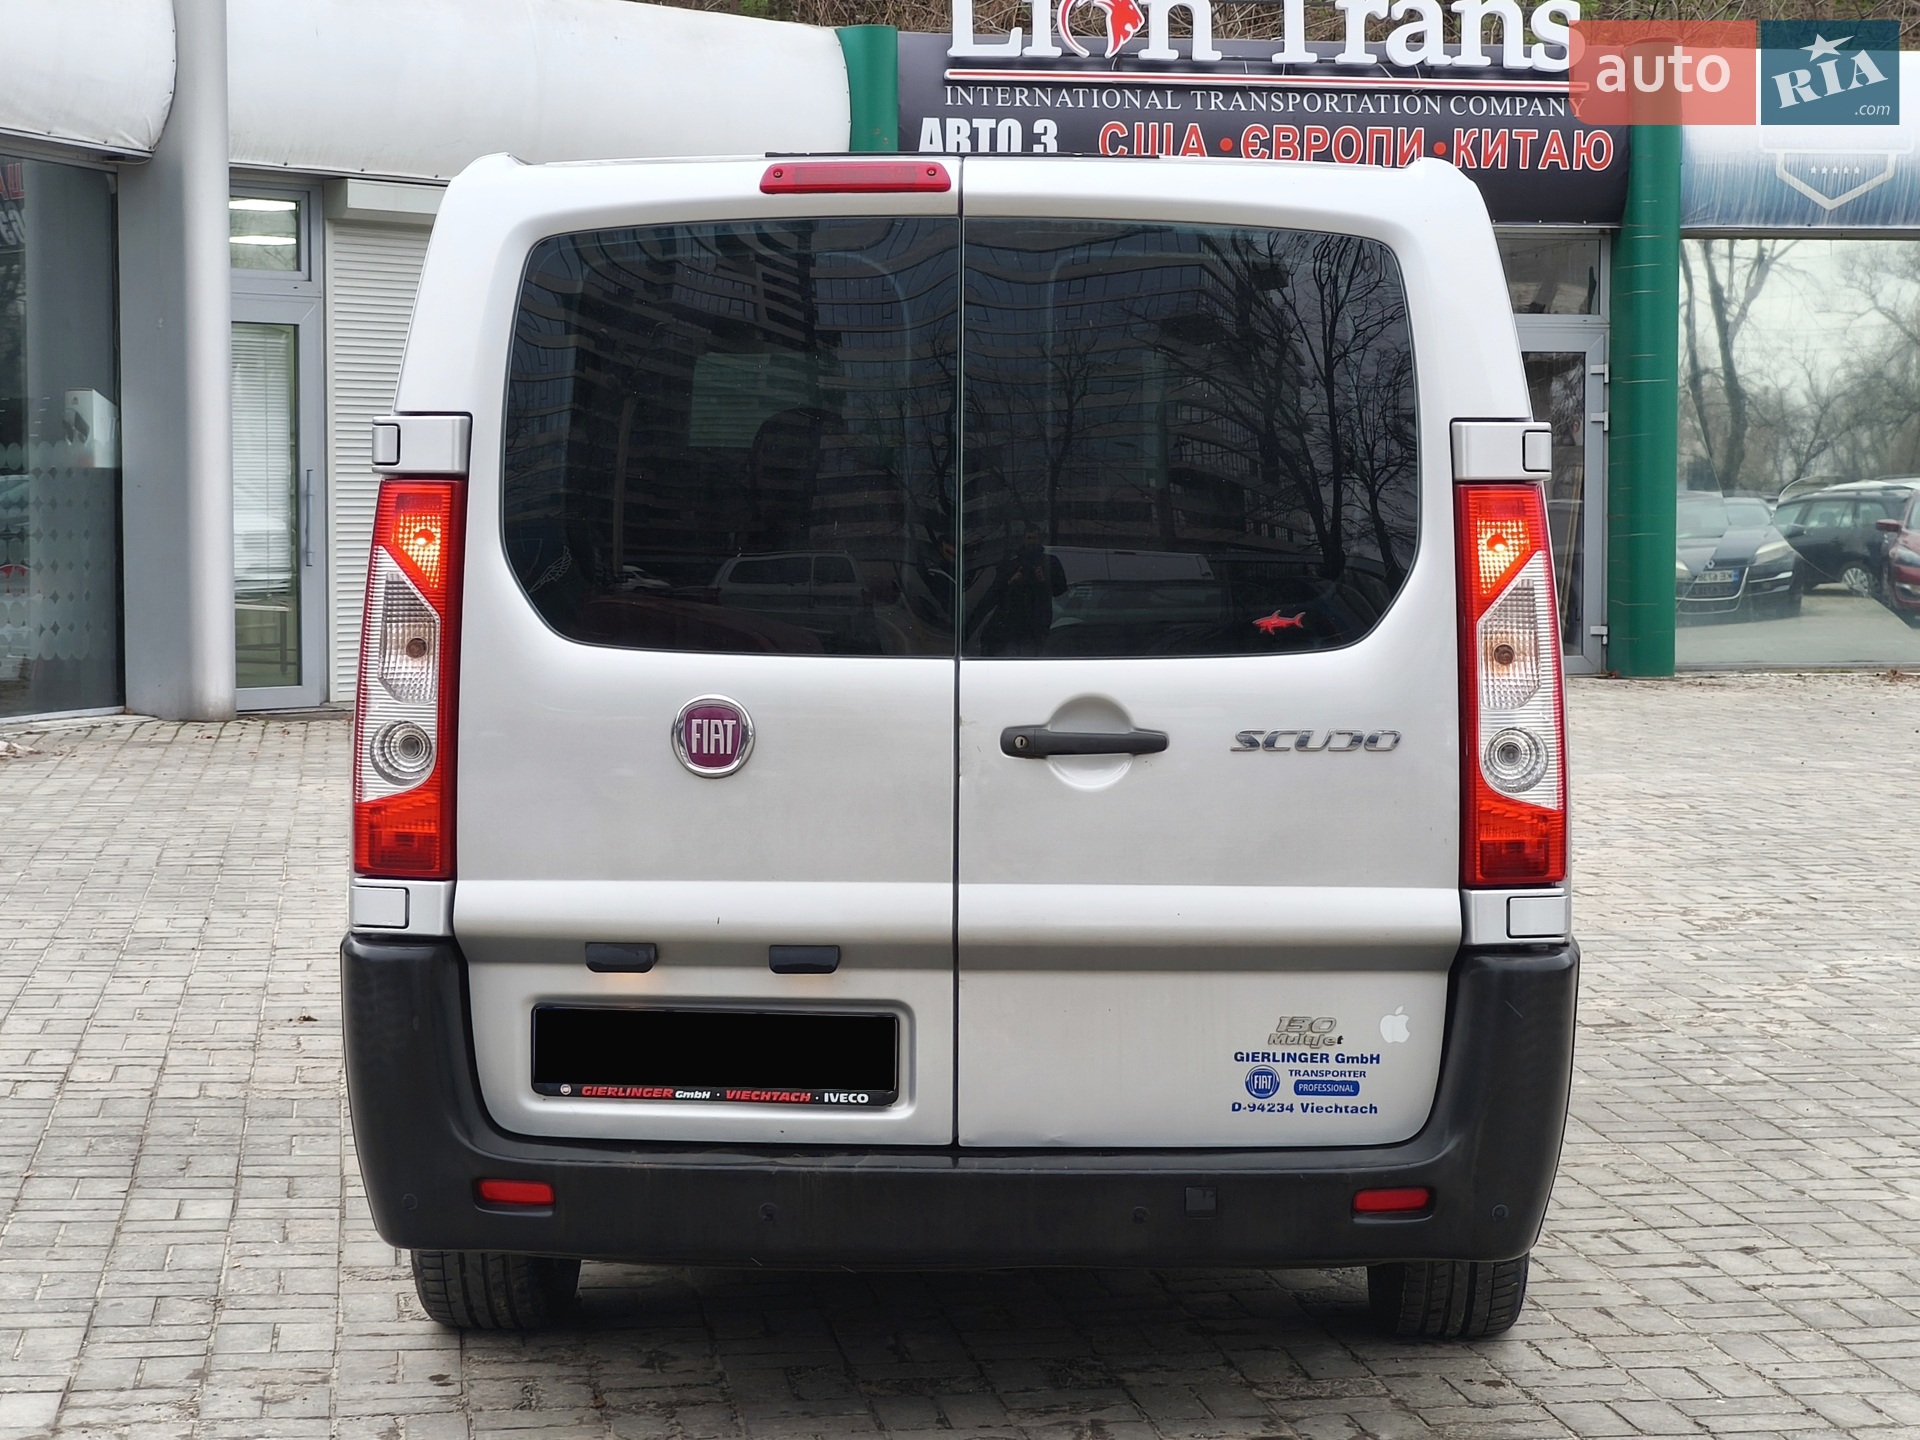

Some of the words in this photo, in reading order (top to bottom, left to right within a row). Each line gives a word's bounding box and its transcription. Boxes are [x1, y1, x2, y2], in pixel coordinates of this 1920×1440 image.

[945, 86, 1182, 110] INTERNATIONAL
[1190, 90, 1441, 116] TRANSPORTATION
[1450, 96, 1586, 118] COMPANY
[918, 117, 1023, 153] АВТО
[1099, 121, 1208, 156] США
[1241, 124, 1425, 168] ЄВРОПИ
[1453, 128, 1614, 171] КИТАЮ
[691, 718, 737, 755] FIAT
[1230, 728, 1402, 752] SCUDO
[1276, 1016, 1337, 1033] 130
[1233, 1051, 1330, 1064] GIERLINGER
[1334, 1053, 1381, 1065] GmbH
[1288, 1069, 1367, 1078] TRANSPORTER
[1254, 1075, 1272, 1090] FIAT
[1298, 1083, 1355, 1093] PROFESSIONAL
[581, 1086, 674, 1098] GIERLINGER
[675, 1090, 711, 1099] GmbH
[725, 1090, 812, 1102] VIECHTACH
[823, 1092, 869, 1104] IVECO
[1231, 1102, 1295, 1113] D-94234
[1300, 1102, 1379, 1115] Viechtach
